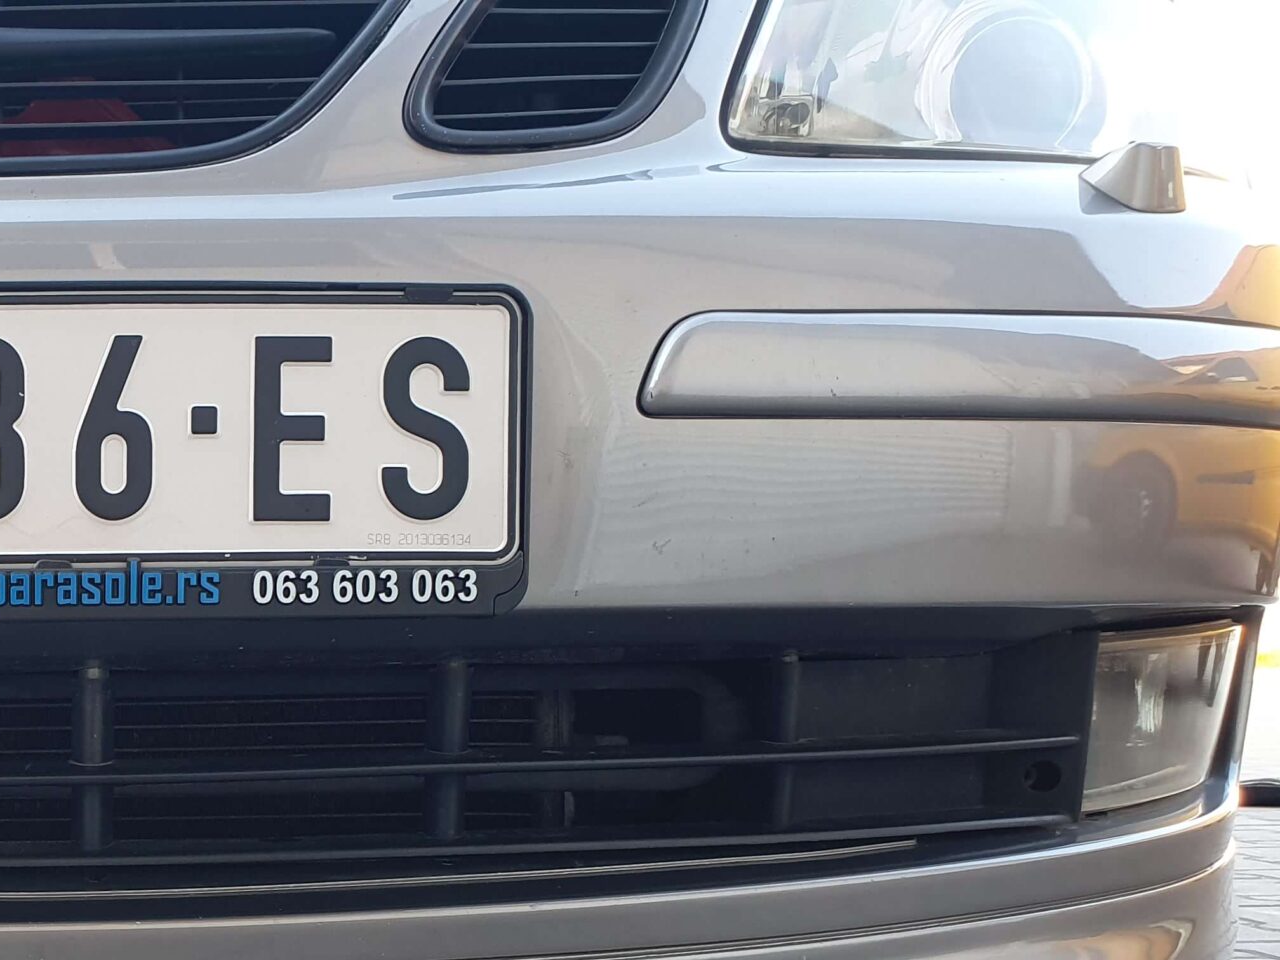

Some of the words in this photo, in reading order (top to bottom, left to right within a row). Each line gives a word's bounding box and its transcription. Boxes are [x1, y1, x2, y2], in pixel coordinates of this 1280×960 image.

[366, 533, 391, 546] SRB
[252, 569, 319, 604] 063
[333, 569, 399, 603] 603
[412, 568, 478, 603] 063
